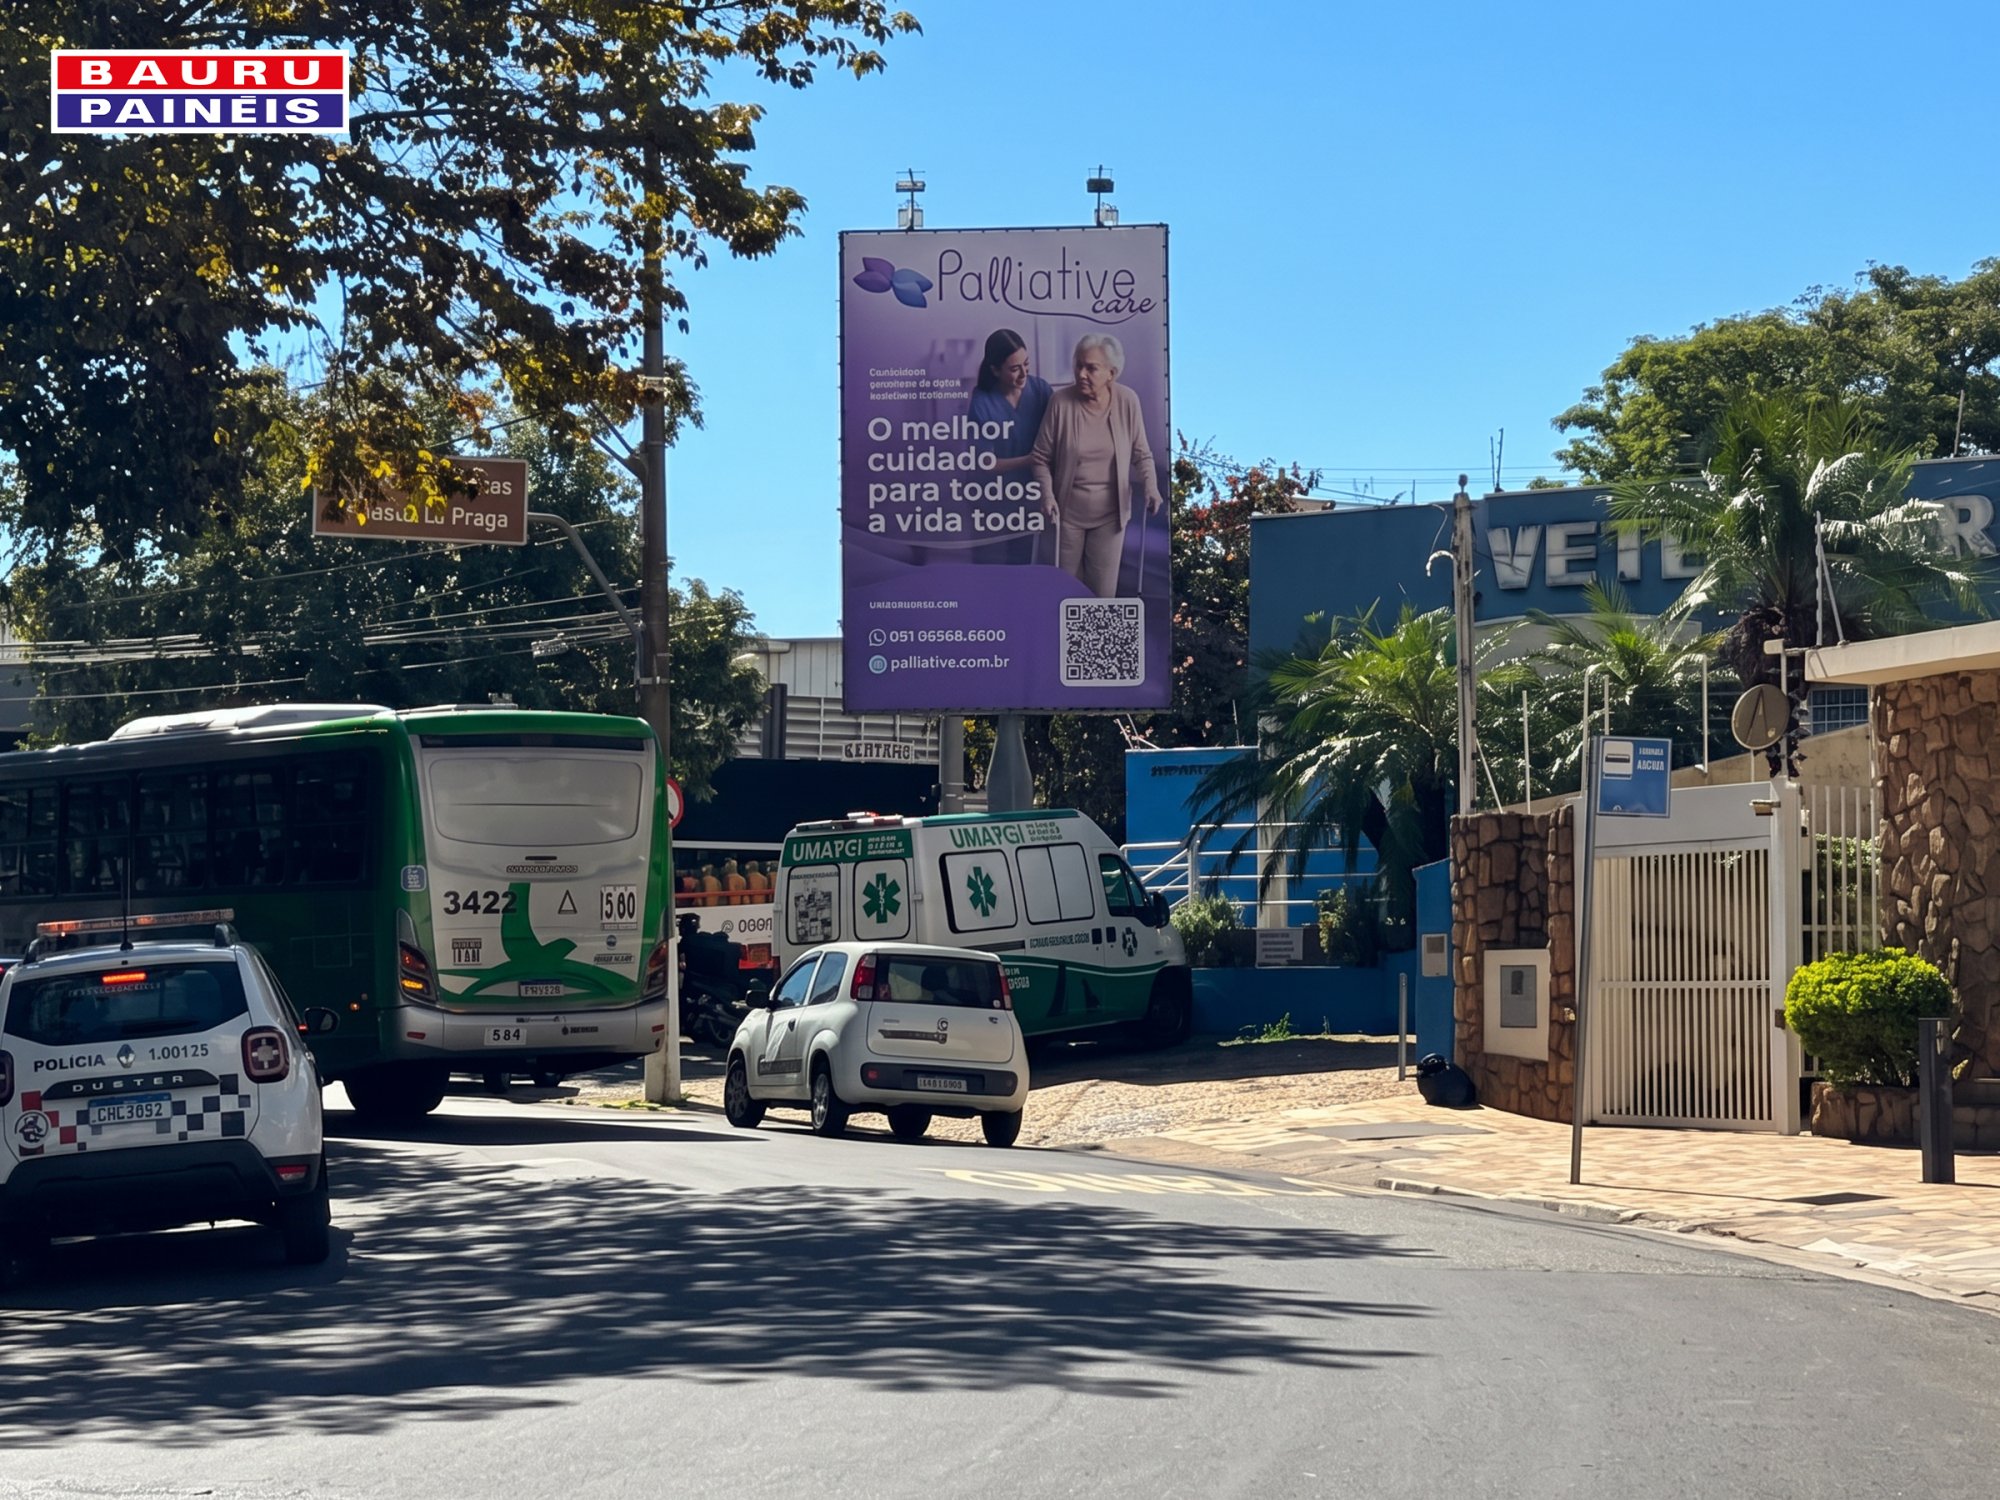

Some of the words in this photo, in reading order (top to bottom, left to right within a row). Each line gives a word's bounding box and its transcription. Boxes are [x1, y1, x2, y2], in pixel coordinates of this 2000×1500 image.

[938, 246, 1136, 308] Palliative
[1091, 298, 1158, 314] care
[867, 417, 893, 442] O
[902, 415, 1015, 441] melhor
[867, 445, 997, 472] cuidado
[869, 481, 940, 509] para
[950, 475, 1042, 501] todos
[452, 507, 508, 532] Praga
[868, 512, 886, 533] a
[896, 506, 963, 532] vida
[972, 506, 1046, 531] toda
[890, 654, 1010, 673] palliative.com.br
[443, 890, 517, 915] 3422
[493, 1030, 521, 1041] 584
[34, 1054, 106, 1073] POLÍCIA
[148, 1043, 210, 1061] 1.00125
[72, 1075, 184, 1093] DUSTER
